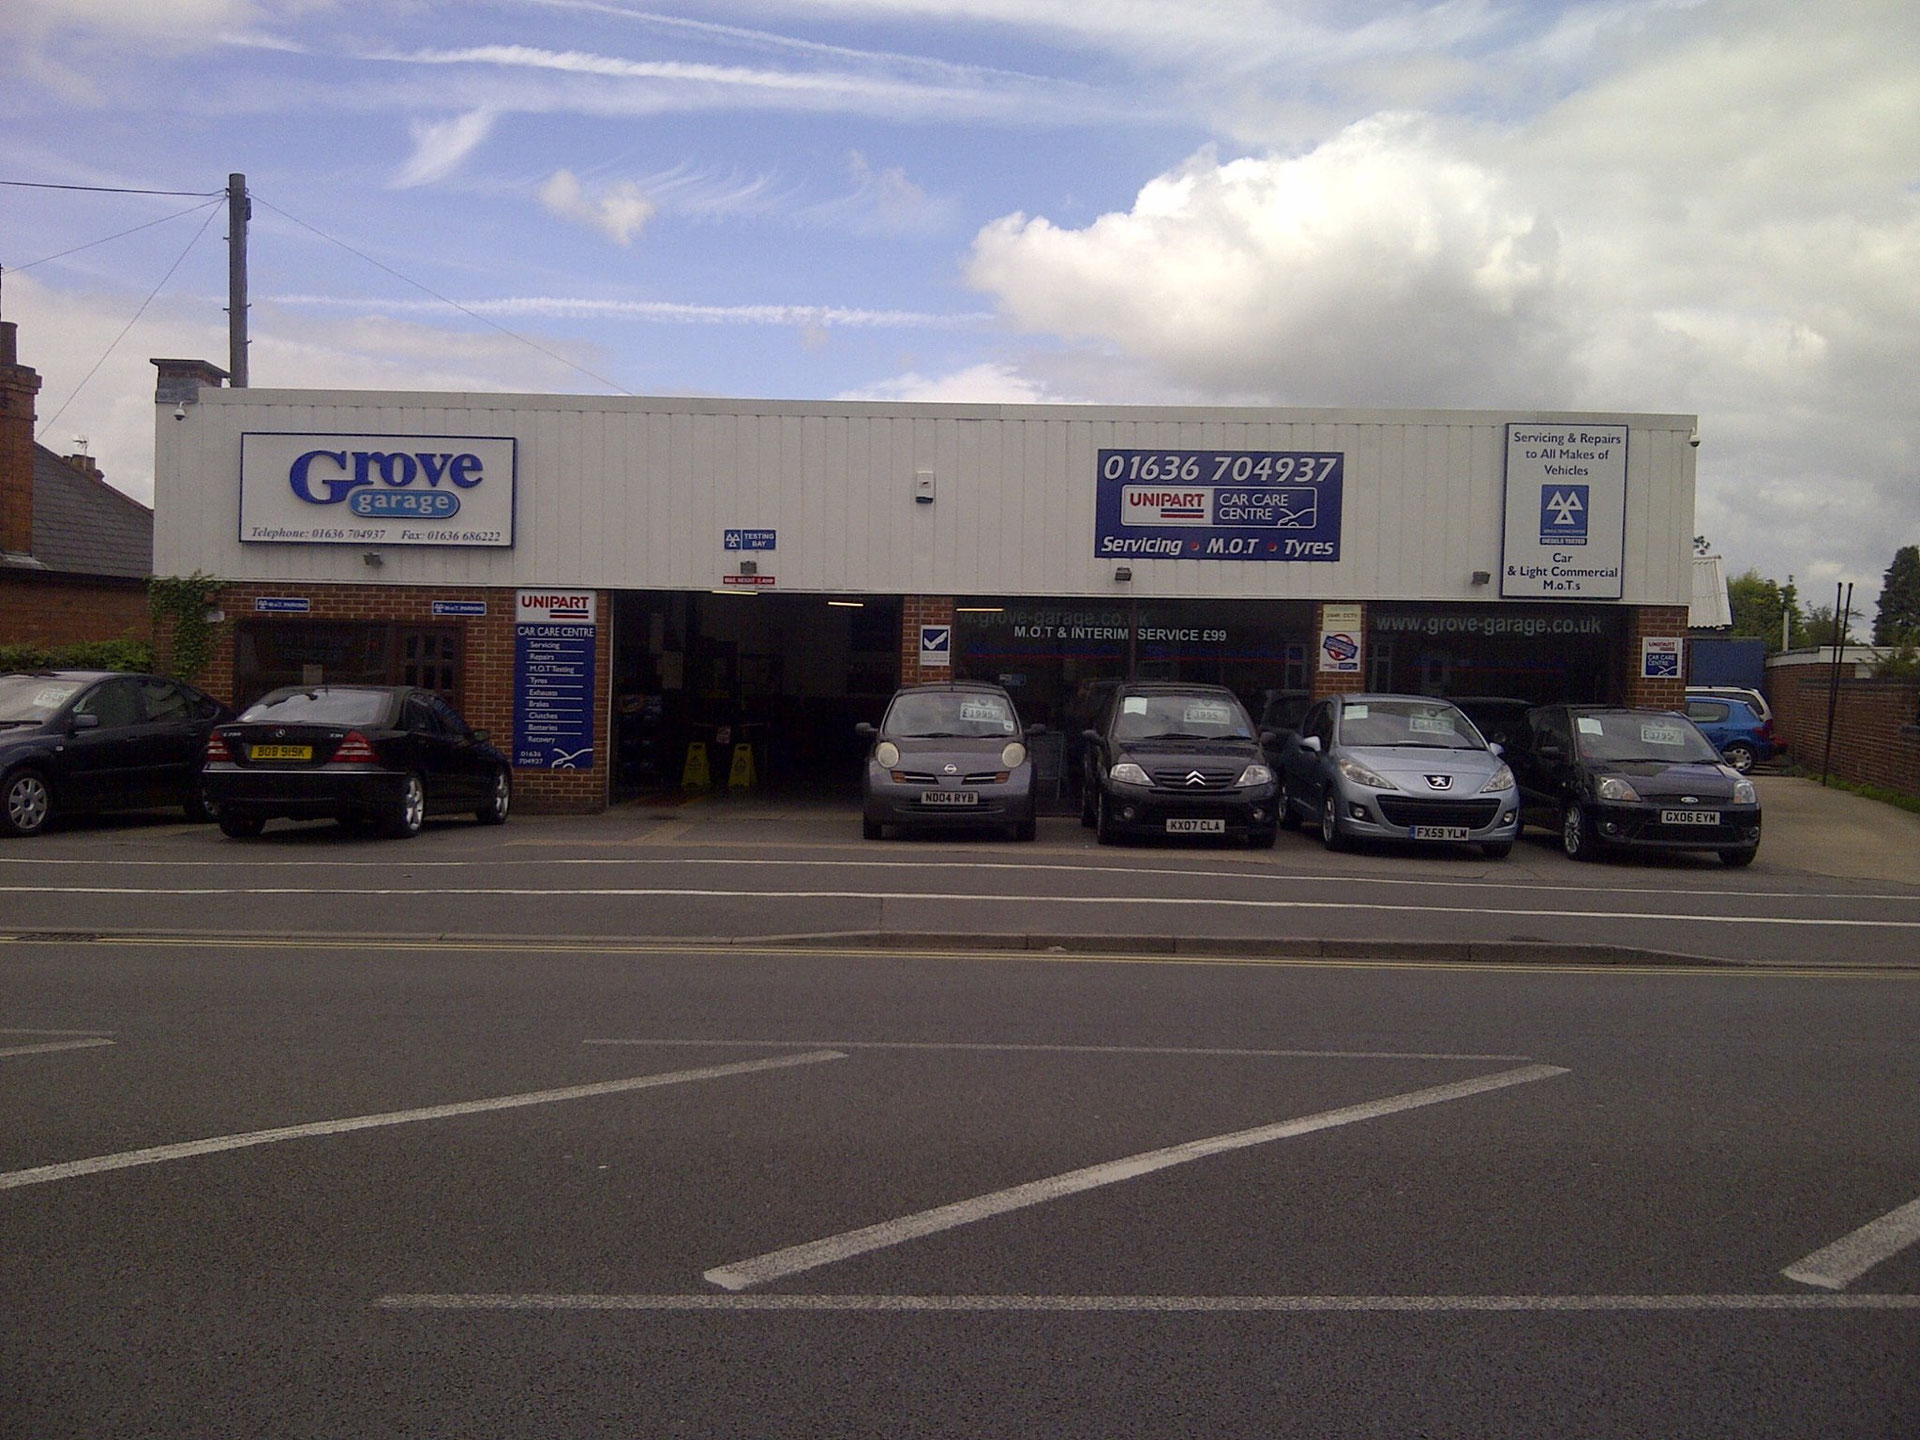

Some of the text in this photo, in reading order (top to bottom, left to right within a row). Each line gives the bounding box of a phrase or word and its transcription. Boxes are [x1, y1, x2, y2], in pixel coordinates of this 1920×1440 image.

[1514, 432, 1621, 446] Servicing & Repairs
[1526, 450, 1609, 460] to All Makes of
[1104, 456, 1337, 482] 01636 704937
[1544, 465, 1589, 476] Vehicles
[289, 450, 484, 505] Grove
[357, 492, 450, 513] garage
[1130, 493, 1204, 507] UNIPART
[1219, 493, 1288, 506] CAR CARE
[1219, 508, 1273, 520] CENTRE
[251, 527, 501, 542] Telephone: 01636 704937 Fax: 01636 686222
[1101, 536, 1334, 557] Servicing M.O.T Tyres
[1552, 553, 1573, 563] Car
[1507, 567, 1618, 579] & Light Commercial
[521, 596, 589, 609] UNIPART
[517, 626, 595, 637] CAR CARE CENTRE
[1376, 616, 1601, 636] www.grove-garage.co.uk
[1014, 626, 1227, 642] M.O.T & INTERIM SERVICE £99
[530, 641, 560, 650] Servicing
[529, 653, 554, 661] Repairs
[552, 666, 575, 674] Testing
[529, 677, 548, 685] Tyres
[529, 689, 558, 697] Exhausts
[529, 700, 550, 708] Brakes
[528, 736, 556, 745] Recovery
[1666, 811, 1693, 822] GX06
[1170, 820, 1220, 831] KX07 CLA
[1417, 827, 1444, 838] FX59
